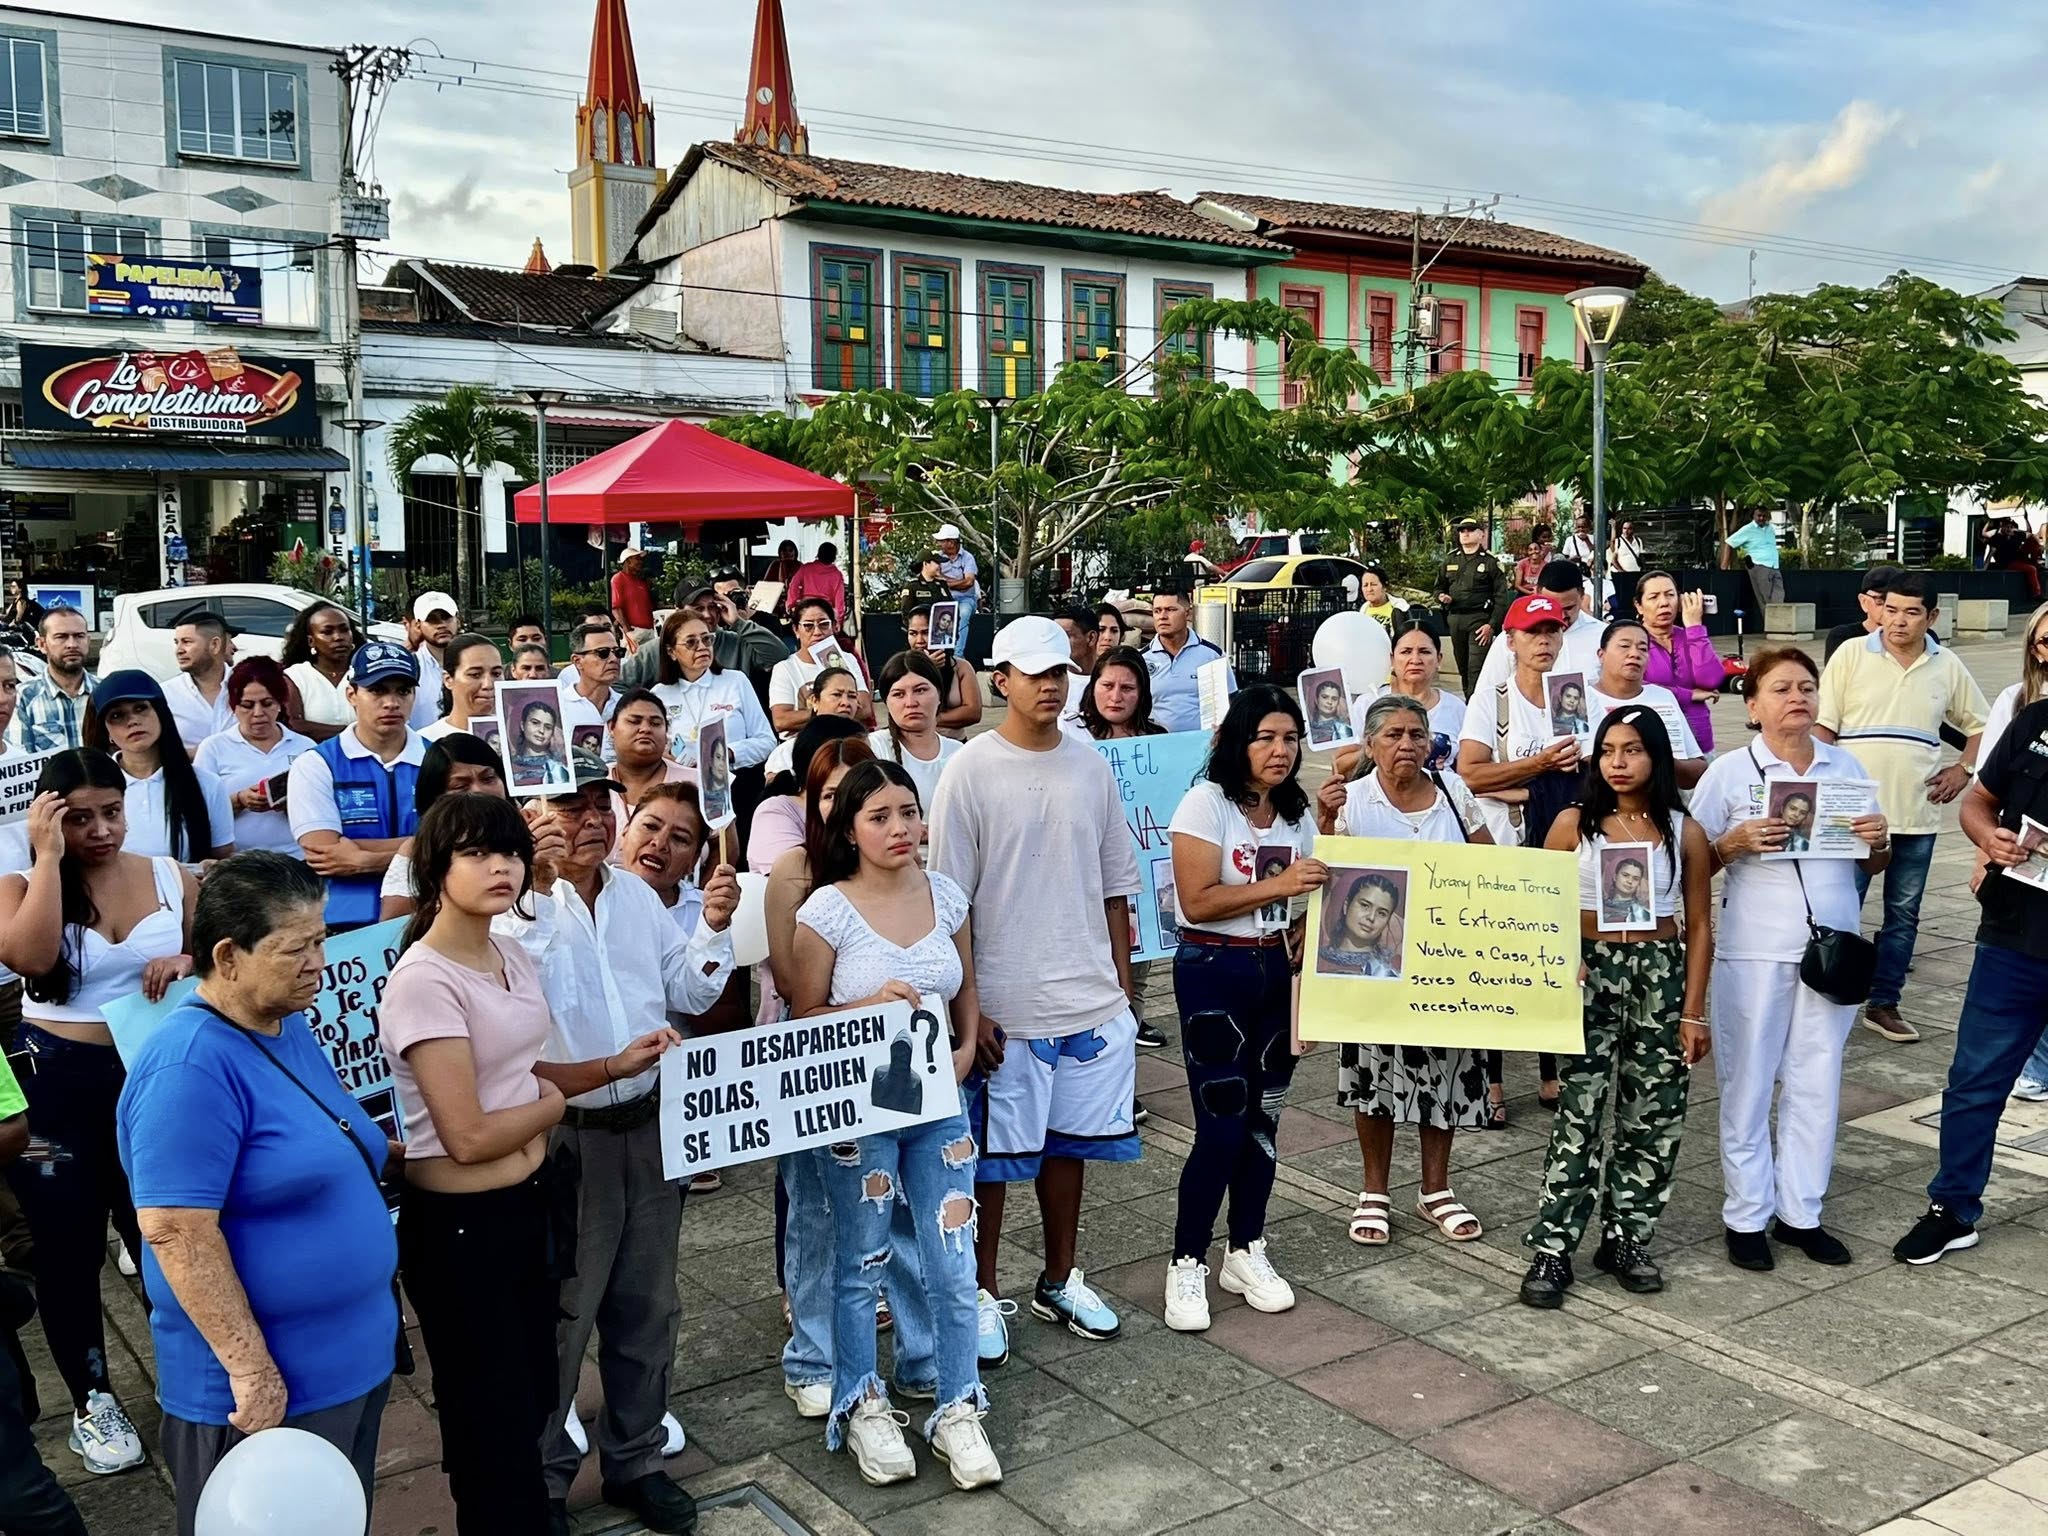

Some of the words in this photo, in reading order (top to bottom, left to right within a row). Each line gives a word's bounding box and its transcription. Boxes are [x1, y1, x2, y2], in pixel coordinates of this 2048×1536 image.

[115, 263, 225, 289] PAPELERÍA
[105, 352, 142, 390] La
[150, 418, 244, 431] DISTRIBUIDORA
[1424, 862, 1471, 899] Yurany
[1477, 874, 1516, 892] Andrea
[1519, 879, 1560, 895] Torres
[1425, 906, 1446, 926] Te
[1459, 907, 1559, 933] Extrañamos
[1417, 942, 1467, 959] Vuelve
[1476, 950, 1485, 959] a
[1537, 946, 1565, 966] tus
[1411, 974, 1455, 986] seres
[1544, 972, 1562, 988] te
[1409, 997, 1519, 1016] necesitamos.
[687, 1047, 717, 1080] NO
[741, 1015, 885, 1068] DESAPARECEN
[683, 1080, 760, 1121] SOLAS,
[780, 1056, 867, 1100] ALGUIEN
[683, 1131, 711, 1164] SE
[729, 1119, 770, 1153] LAS
[794, 1099, 863, 1138] LLEVO.
